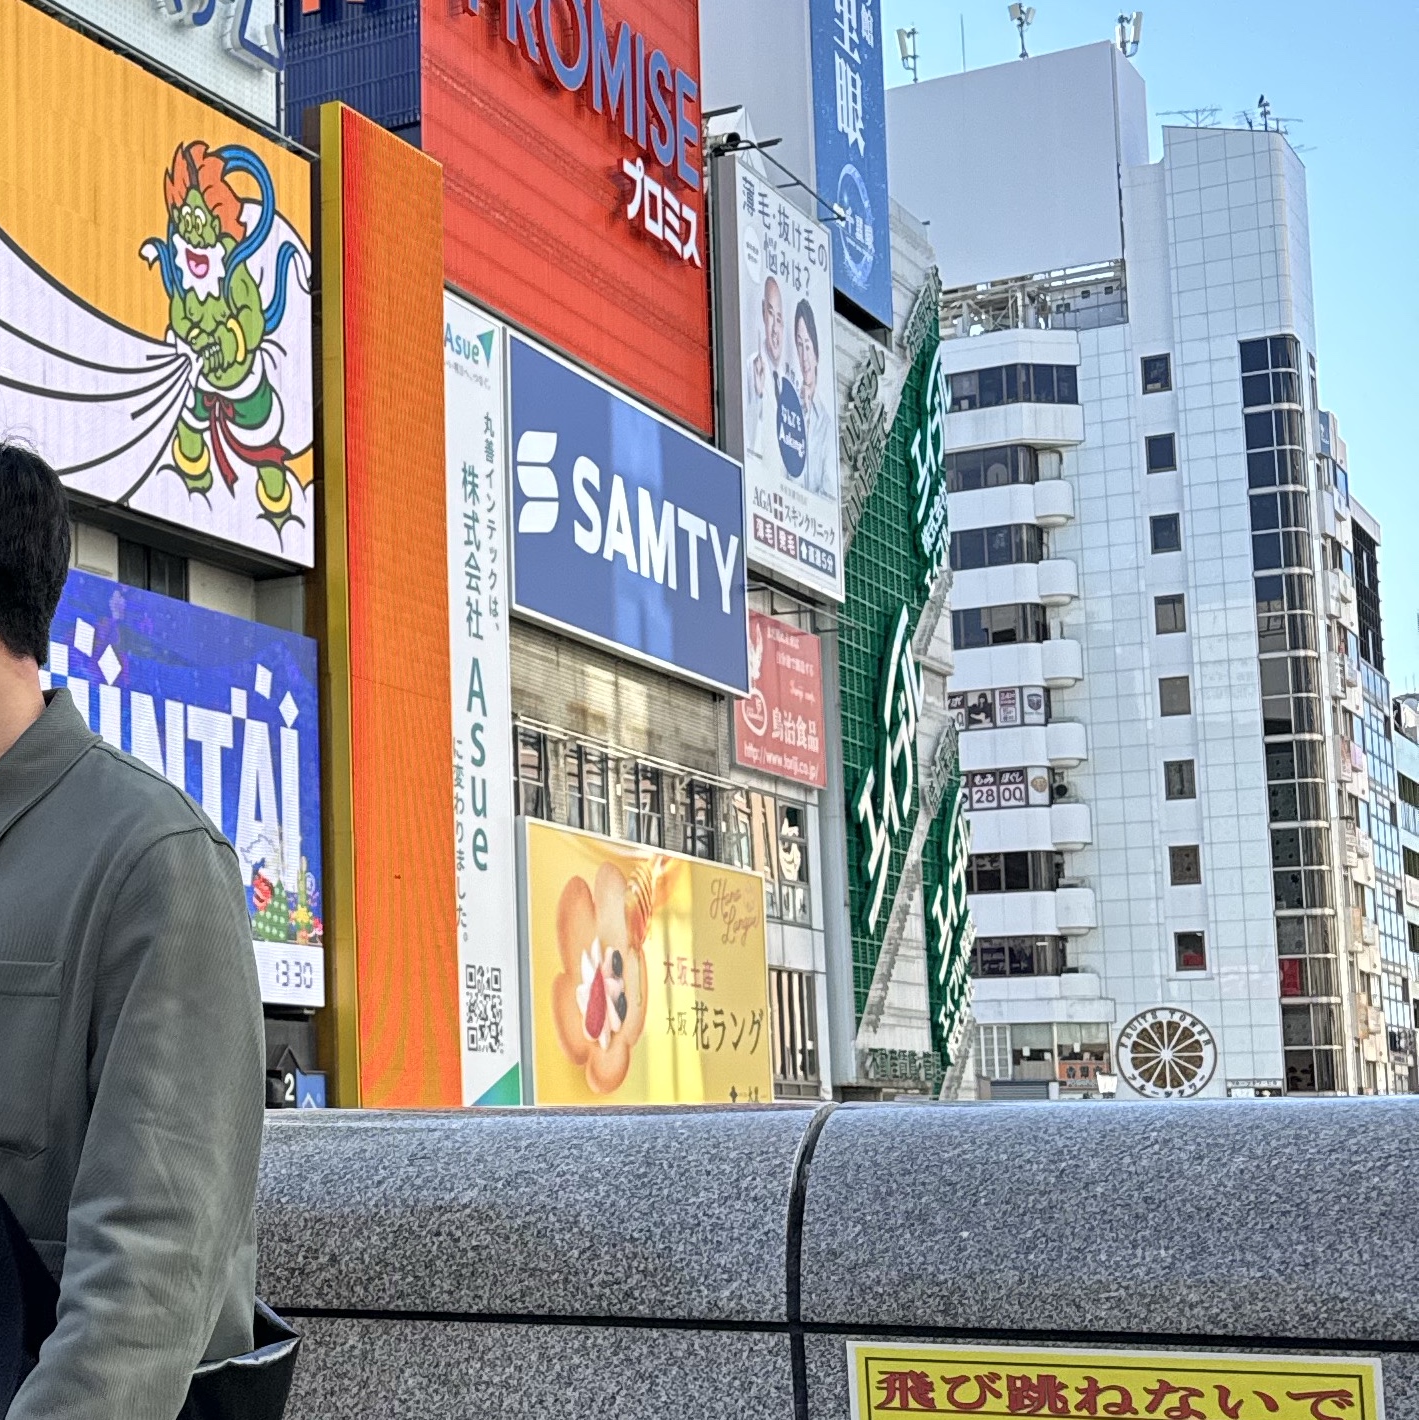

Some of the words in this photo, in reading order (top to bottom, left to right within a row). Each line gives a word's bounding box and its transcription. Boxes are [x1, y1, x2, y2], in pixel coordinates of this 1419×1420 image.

[468, 0, 699, 191] ROMISE
[623, 157, 702, 268] プロミス
[444, 322, 479, 365] Asue
[462, 461, 484, 640] 株式会社
[572, 455, 739, 615] SAMTY
[466, 656, 489, 871] Asue
[663, 957, 716, 992] 大阪土産
